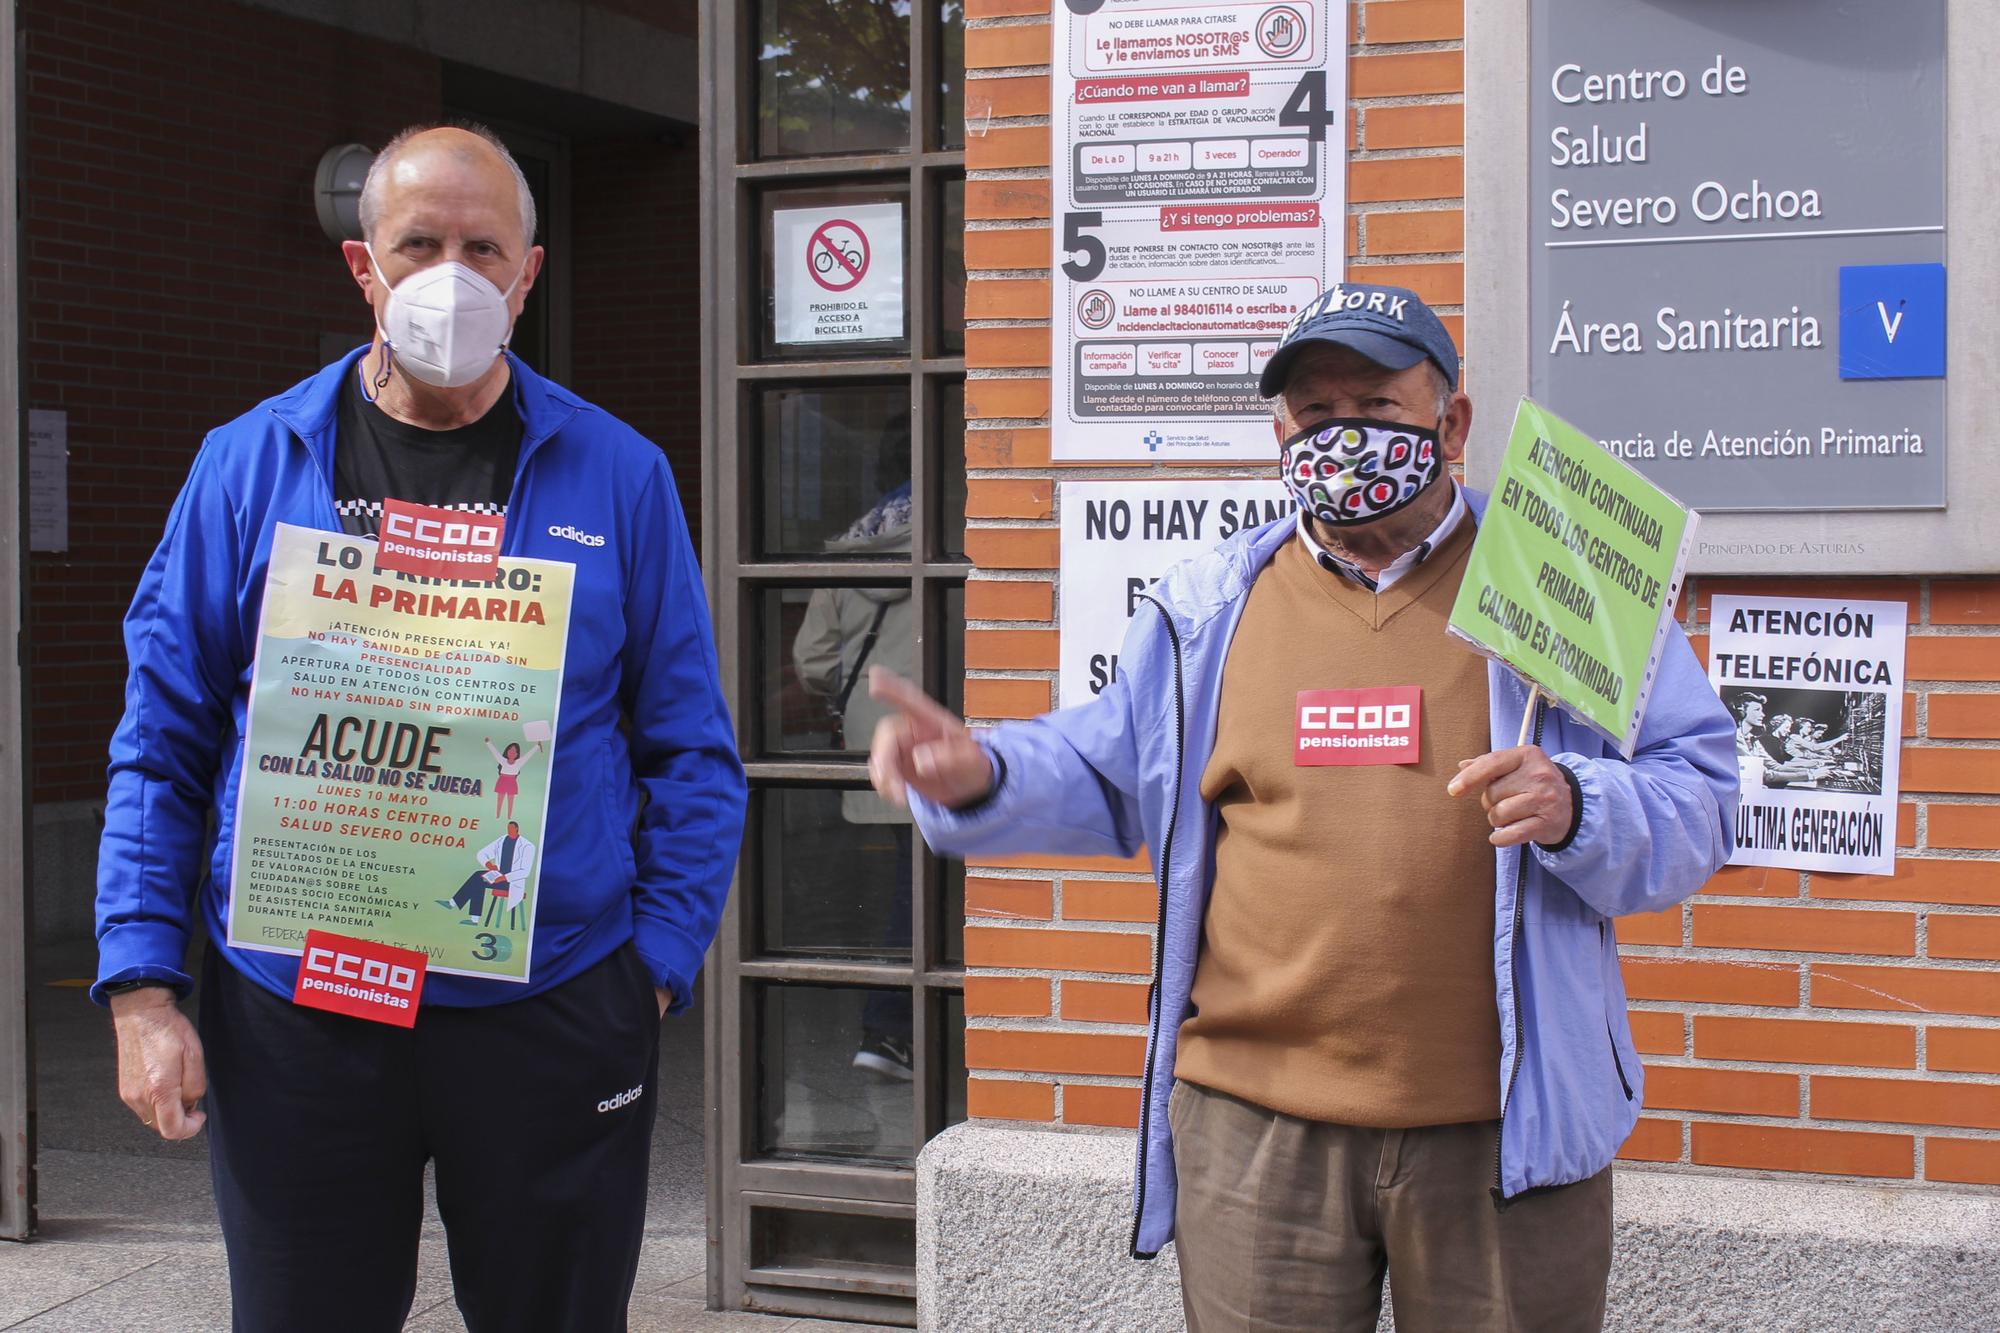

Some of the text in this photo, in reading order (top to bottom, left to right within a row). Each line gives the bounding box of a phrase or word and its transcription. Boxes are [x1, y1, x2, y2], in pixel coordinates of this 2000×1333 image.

[1109, 15, 1236, 30] NO DEBE LLAMAR PARA CITARSE
[1096, 31, 1250, 50] Le llamamos NOSOTR@S
[1106, 44, 1240, 64] y le enviamos un SMS
[1078, 78, 1247, 101] ¿Cúando me van a llamar?
[1552, 54, 1747, 104] Centro de
[1279, 71, 1334, 142] 4
[1551, 122, 1647, 166] Salud
[1162, 209, 1316, 228] ¿Y si tengo problemas?
[1551, 179, 1822, 229] Severo Ochoa
[1061, 212, 1106, 282] 5
[1130, 285, 1288, 297] NO LLAME A SU CENTRO DE SALUD
[810, 302, 868, 312] PROHIBIDO EL
[818, 314, 860, 323] ACCESO A
[1123, 303, 1296, 316] Llame al 984016114 o escriba a
[815, 325, 864, 334] BICICLETAS
[1550, 300, 1903, 354] Área Sanitaria V
[1664, 430, 1693, 458] de
[1701, 429, 1810, 458] Atención
[1820, 427, 1924, 455] Primaria
[1528, 437, 1664, 553] ATENCIÓN CONTINUADA
[386, 512, 498, 546] CCOO
[1086, 499, 1131, 541] NO
[1143, 500, 1209, 541] HAY
[548, 525, 606, 547] adidas
[1501, 476, 1661, 610] EN TODOS LOS CENTROS DE
[317, 542, 363, 570] LO
[384, 541, 493, 564] pensionistas
[312, 574, 358, 604] LA
[369, 584, 546, 626] PRIMARIA
[1536, 561, 1596, 625] PRIMARIA
[329, 621, 510, 650] ¡ATENCIÓN PRESENCIAL YA!
[1729, 607, 1874, 639] ATENCIÓN
[308, 630, 528, 666] NO HAY SANIDAD DE CALIDAD SIN
[1478, 584, 1624, 706] CALIDAD ES PROXIMIDAD
[281, 655, 536, 694] APERTURA DE TODOS LOS CENTROS DE
[361, 653, 472, 676] PRESENCIALIDAD
[1716, 652, 1892, 686] TELEFÓNICA
[291, 686, 519, 721] NO HAY SANIDAD SIN PROXIMIDAD
[294, 672, 520, 706] SALUD EN ATENCIÓN CONTINUADA
[1300, 704, 1410, 730] CCOO
[300, 713, 452, 774] ACUDE
[1300, 734, 1409, 750] pensionistas
[258, 754, 483, 798] CON LA SALUD NO SE JUEGA
[317, 784, 428, 806] LUNES 10 MAYO
[274, 796, 480, 831] 11:00 HORAS CENTRO DE
[1735, 794, 1883, 858] ÚLTIMA GENERACIÓN
[254, 836, 377, 859] PRESENTACIÓN DE LOS
[280, 816, 466, 849] SALUD SEVERO OCHOA
[252, 848, 416, 876] RESULTADOS DE LA ENCUESTA
[252, 860, 379, 882] DE VALORACIÓN DE LOS
[250, 872, 388, 895] CIUDADAN@S SOBRE LAS
[250, 882, 420, 910] MEDIDAS SOCIO ECONÓMICAS Y
[248, 904, 374, 928] DURANTE LA PANDEMIA
[249, 894, 392, 918] DE ASISTENCIA SANITARIA
[306, 947, 416, 992] CCOO
[302, 976, 409, 1010] pensionistas
[597, 1084, 643, 1113] adidas
